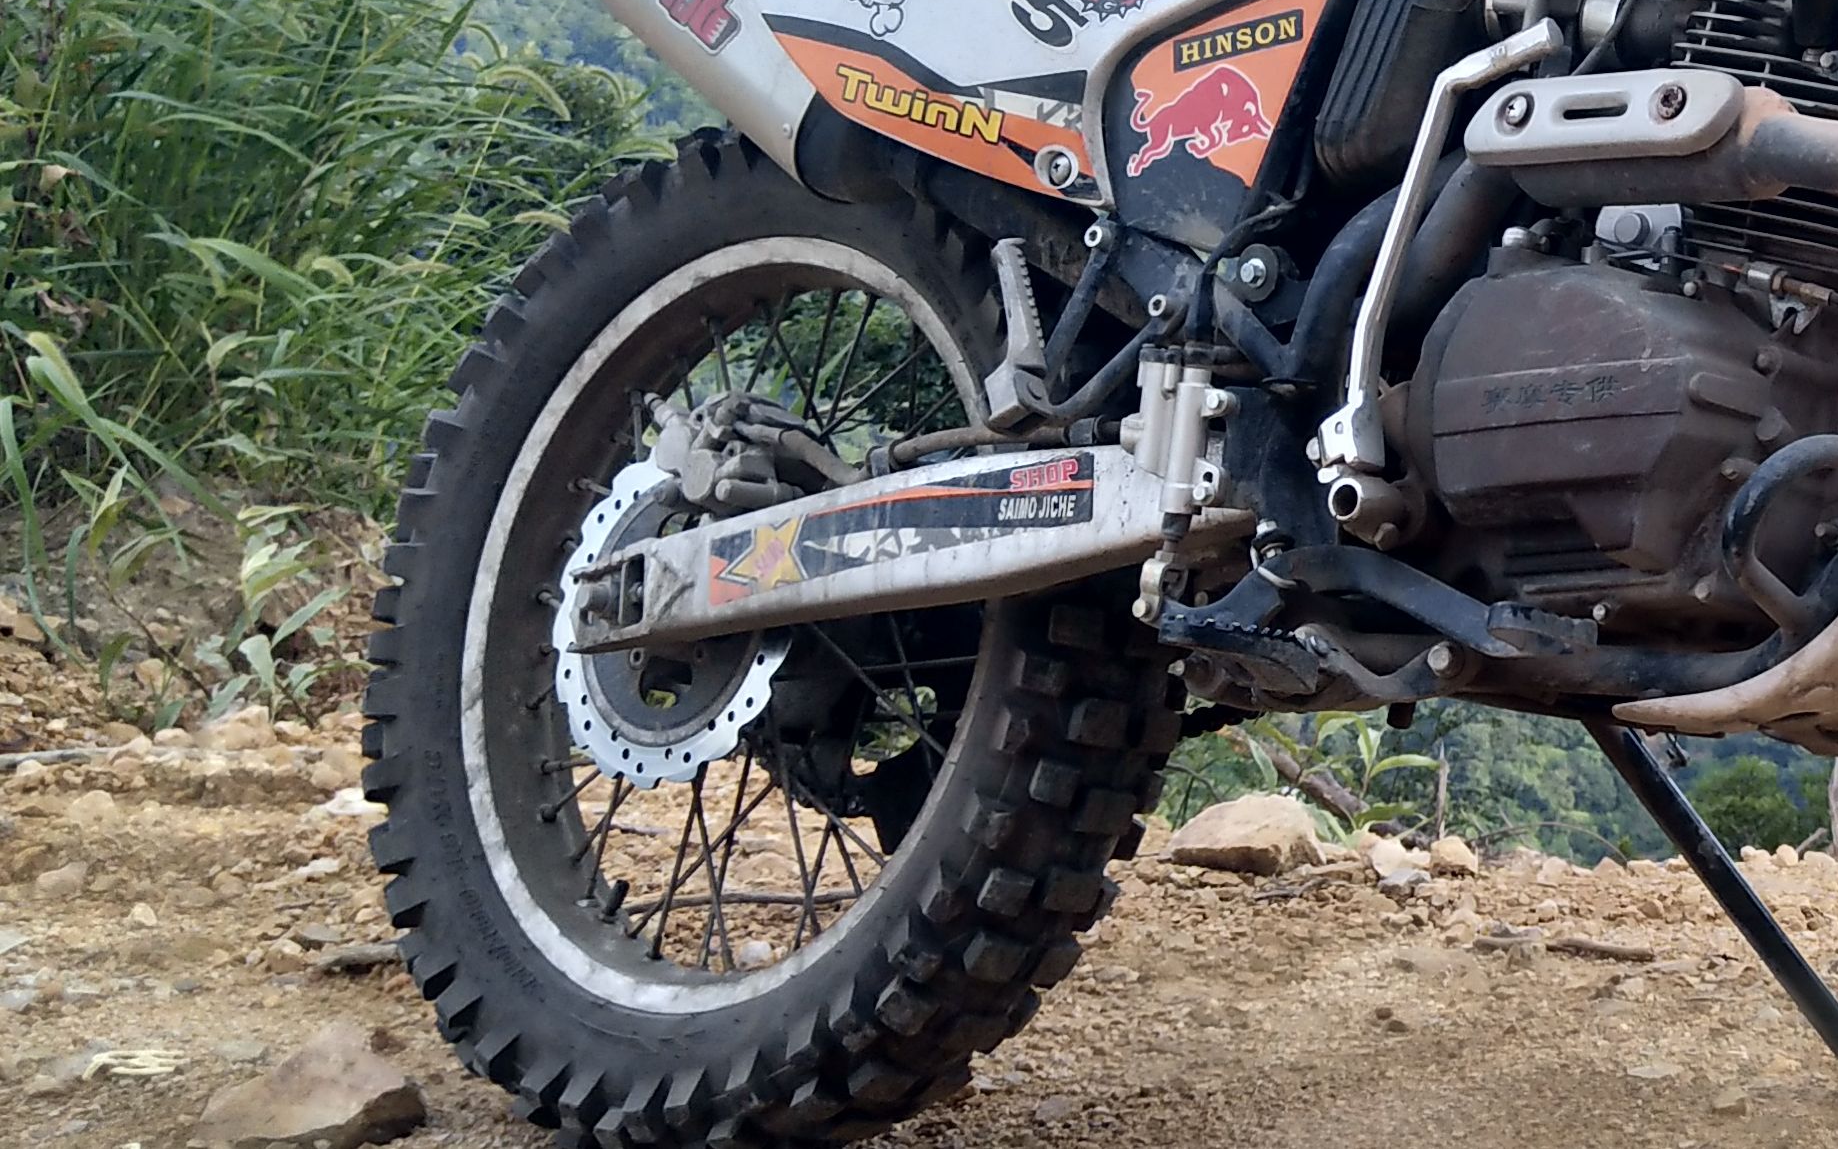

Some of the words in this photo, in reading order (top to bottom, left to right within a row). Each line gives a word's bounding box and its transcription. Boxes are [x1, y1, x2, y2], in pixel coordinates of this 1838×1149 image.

[1179, 15, 1298, 66] HINSON
[1009, 458, 1079, 493] SHOP
[997, 496, 1038, 522] SAIMO
[1038, 494, 1078, 519] JICHE
